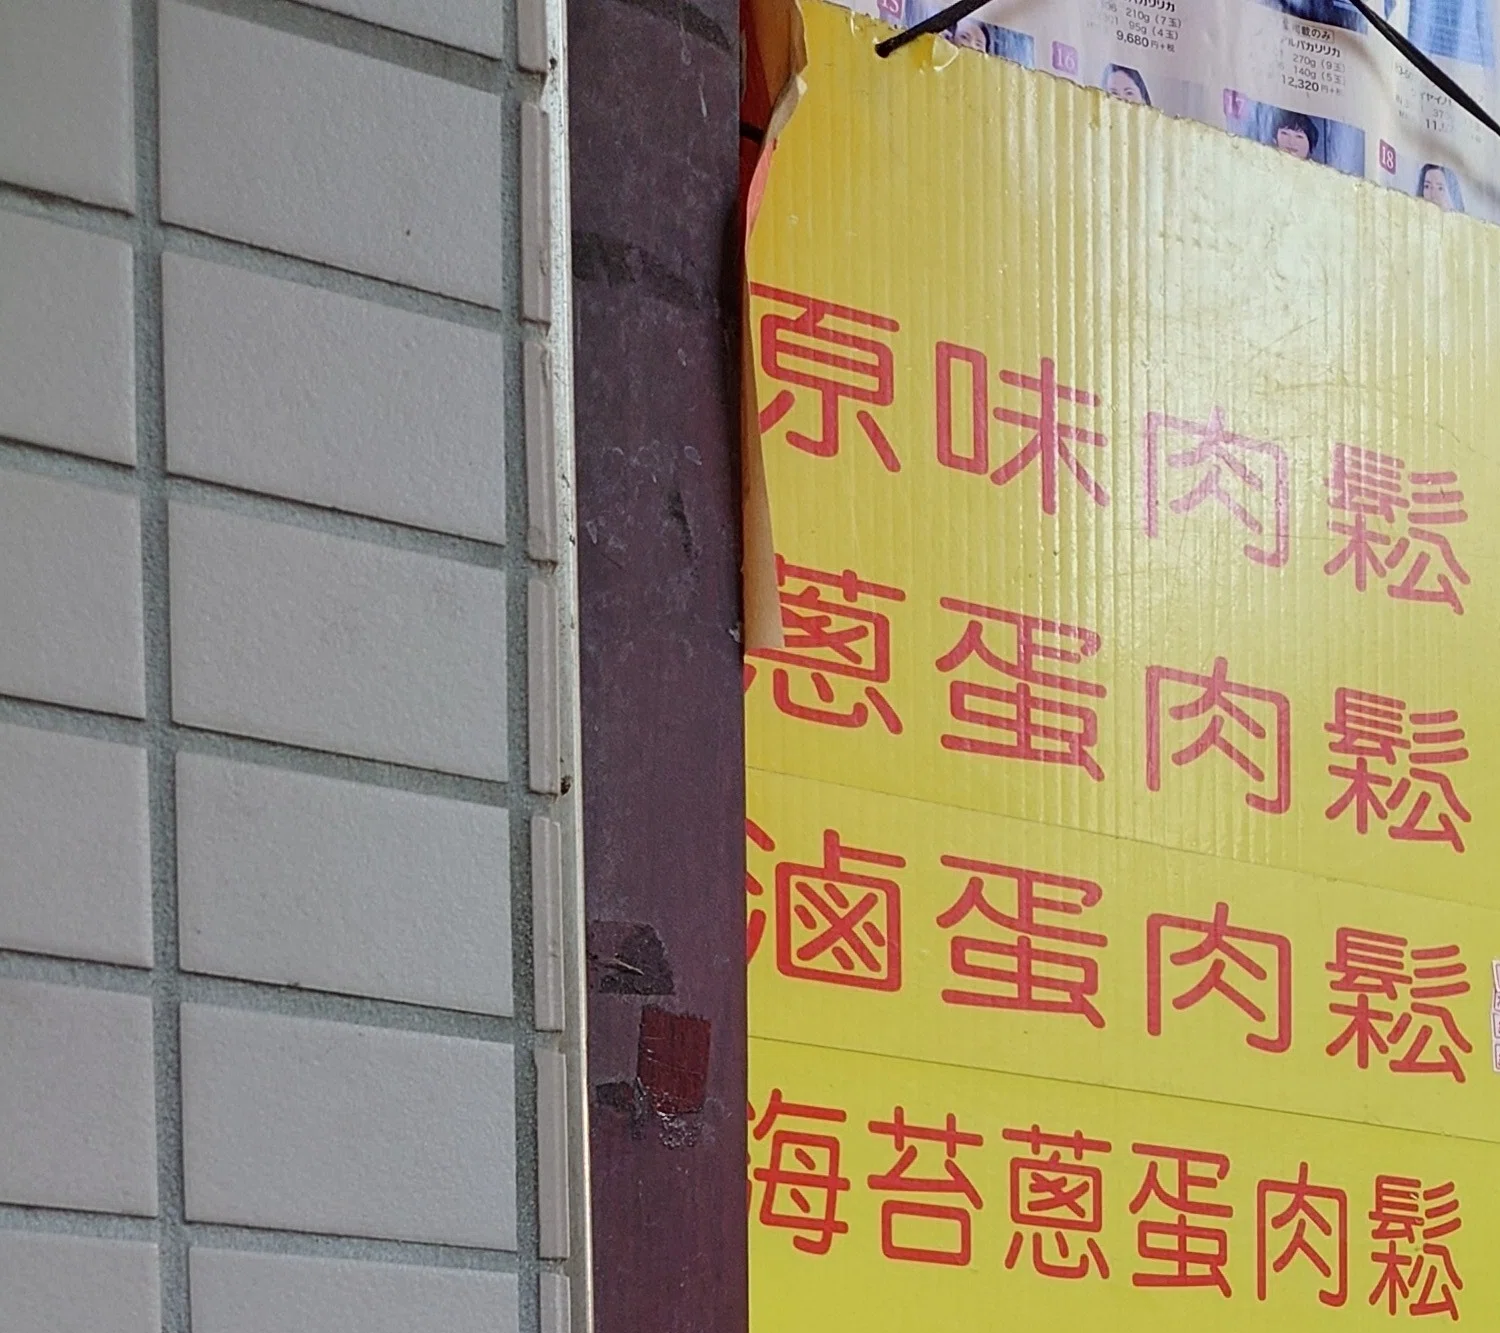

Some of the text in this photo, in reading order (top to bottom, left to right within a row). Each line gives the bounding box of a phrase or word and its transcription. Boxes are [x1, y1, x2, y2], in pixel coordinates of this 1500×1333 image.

[1380, 147, 1394, 170] 18
[750, 280, 1467, 615] 原味肉鬆
[747, 553, 1473, 856] 蔥蛋肉鬆
[748, 814, 1473, 1086] 滷蛋肉鬆
[750, 1088, 1463, 1320] 海苔蔥蛋肉鬆
